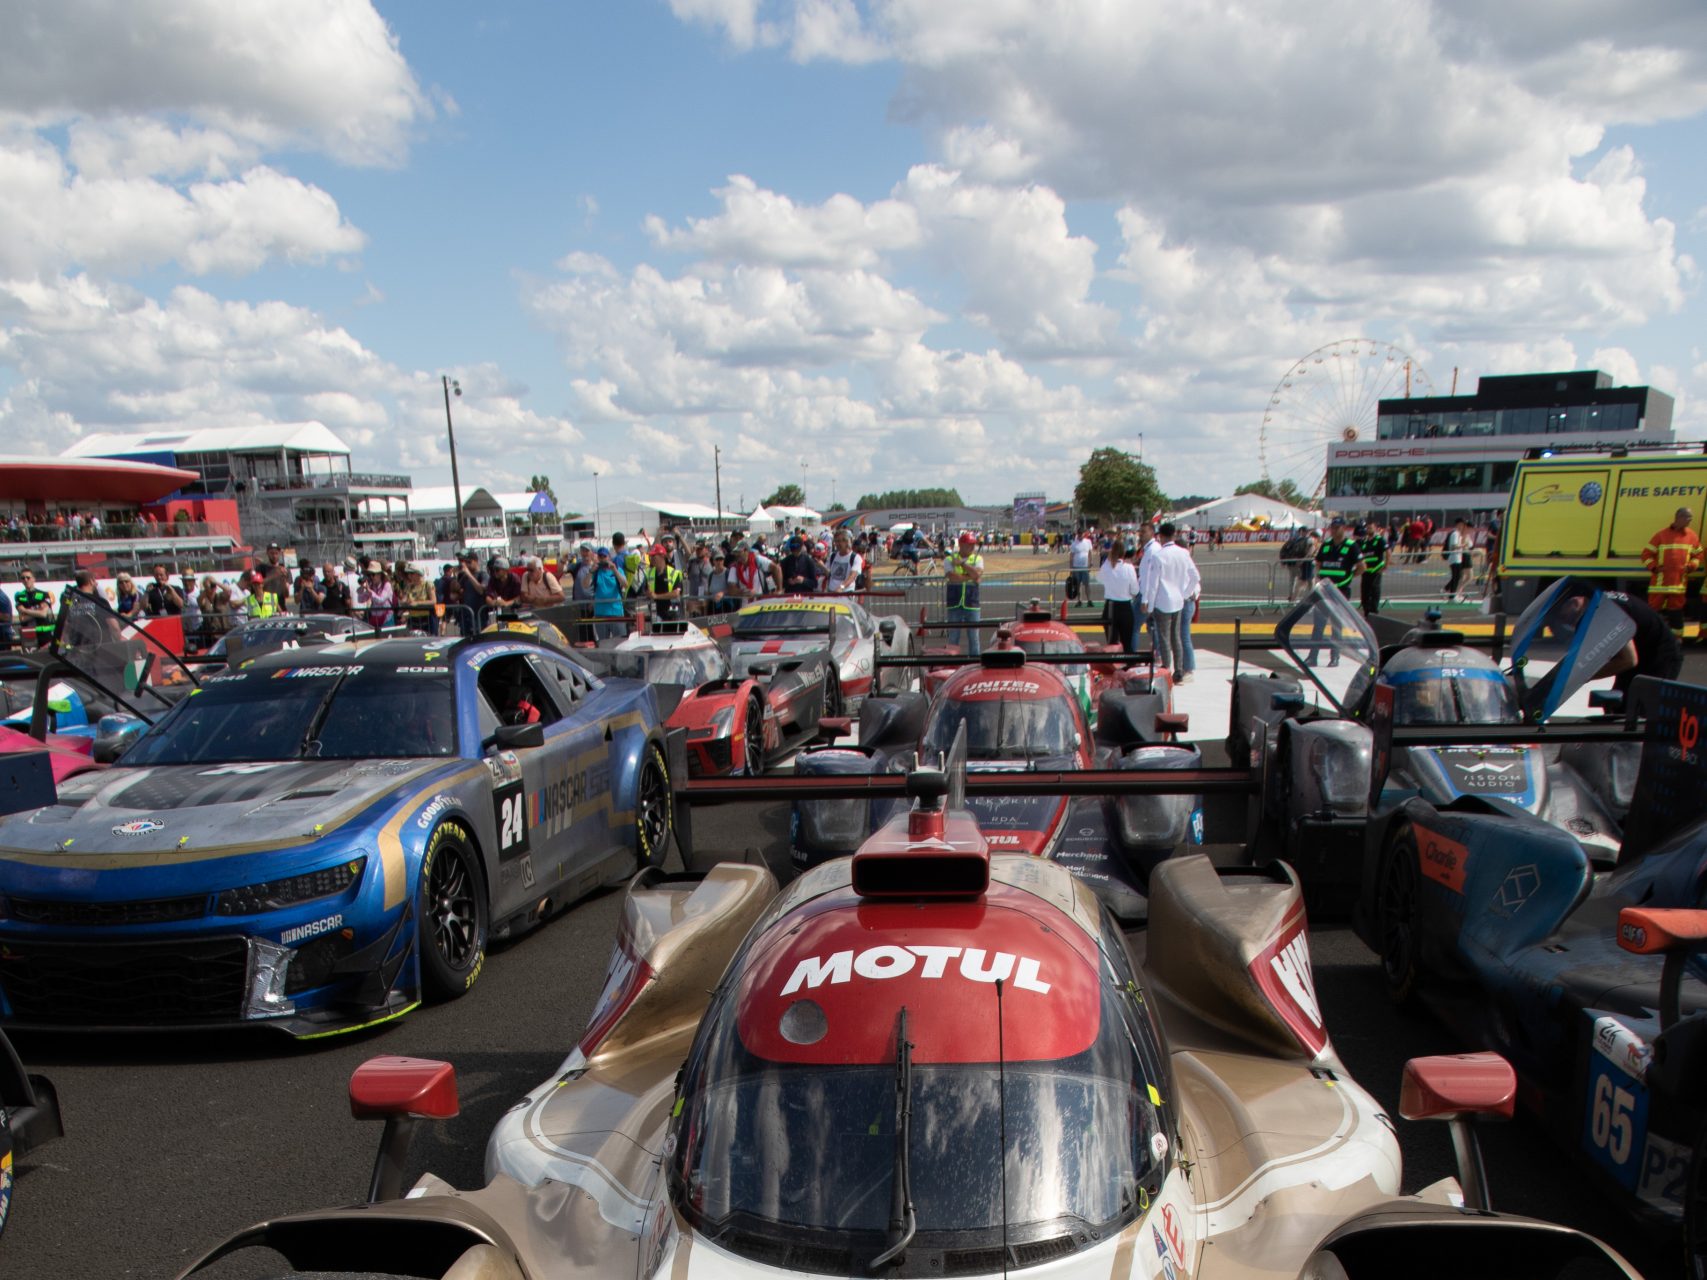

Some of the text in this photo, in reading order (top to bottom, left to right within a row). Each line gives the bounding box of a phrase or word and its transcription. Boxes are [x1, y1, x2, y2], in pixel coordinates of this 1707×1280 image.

[1335, 448, 1426, 458] PORSCHE
[1619, 486, 1706, 497] FIRE SAFETY
[888, 511, 956, 520] PORSCHE
[707, 615, 729, 626] CADILLAC
[292, 665, 364, 677] NASCAR
[961, 687, 1037, 698] AUTOSPORTS
[963, 680, 1041, 692] UNITED
[544, 771, 587, 820] NASCAR
[501, 793, 523, 849] 24
[295, 914, 344, 940] NASCAR
[1622, 923, 1637, 942] elf
[779, 945, 1052, 997] MOTUL
[1592, 1073, 1635, 1165] 65
[1643, 1144, 1689, 1202] P2
